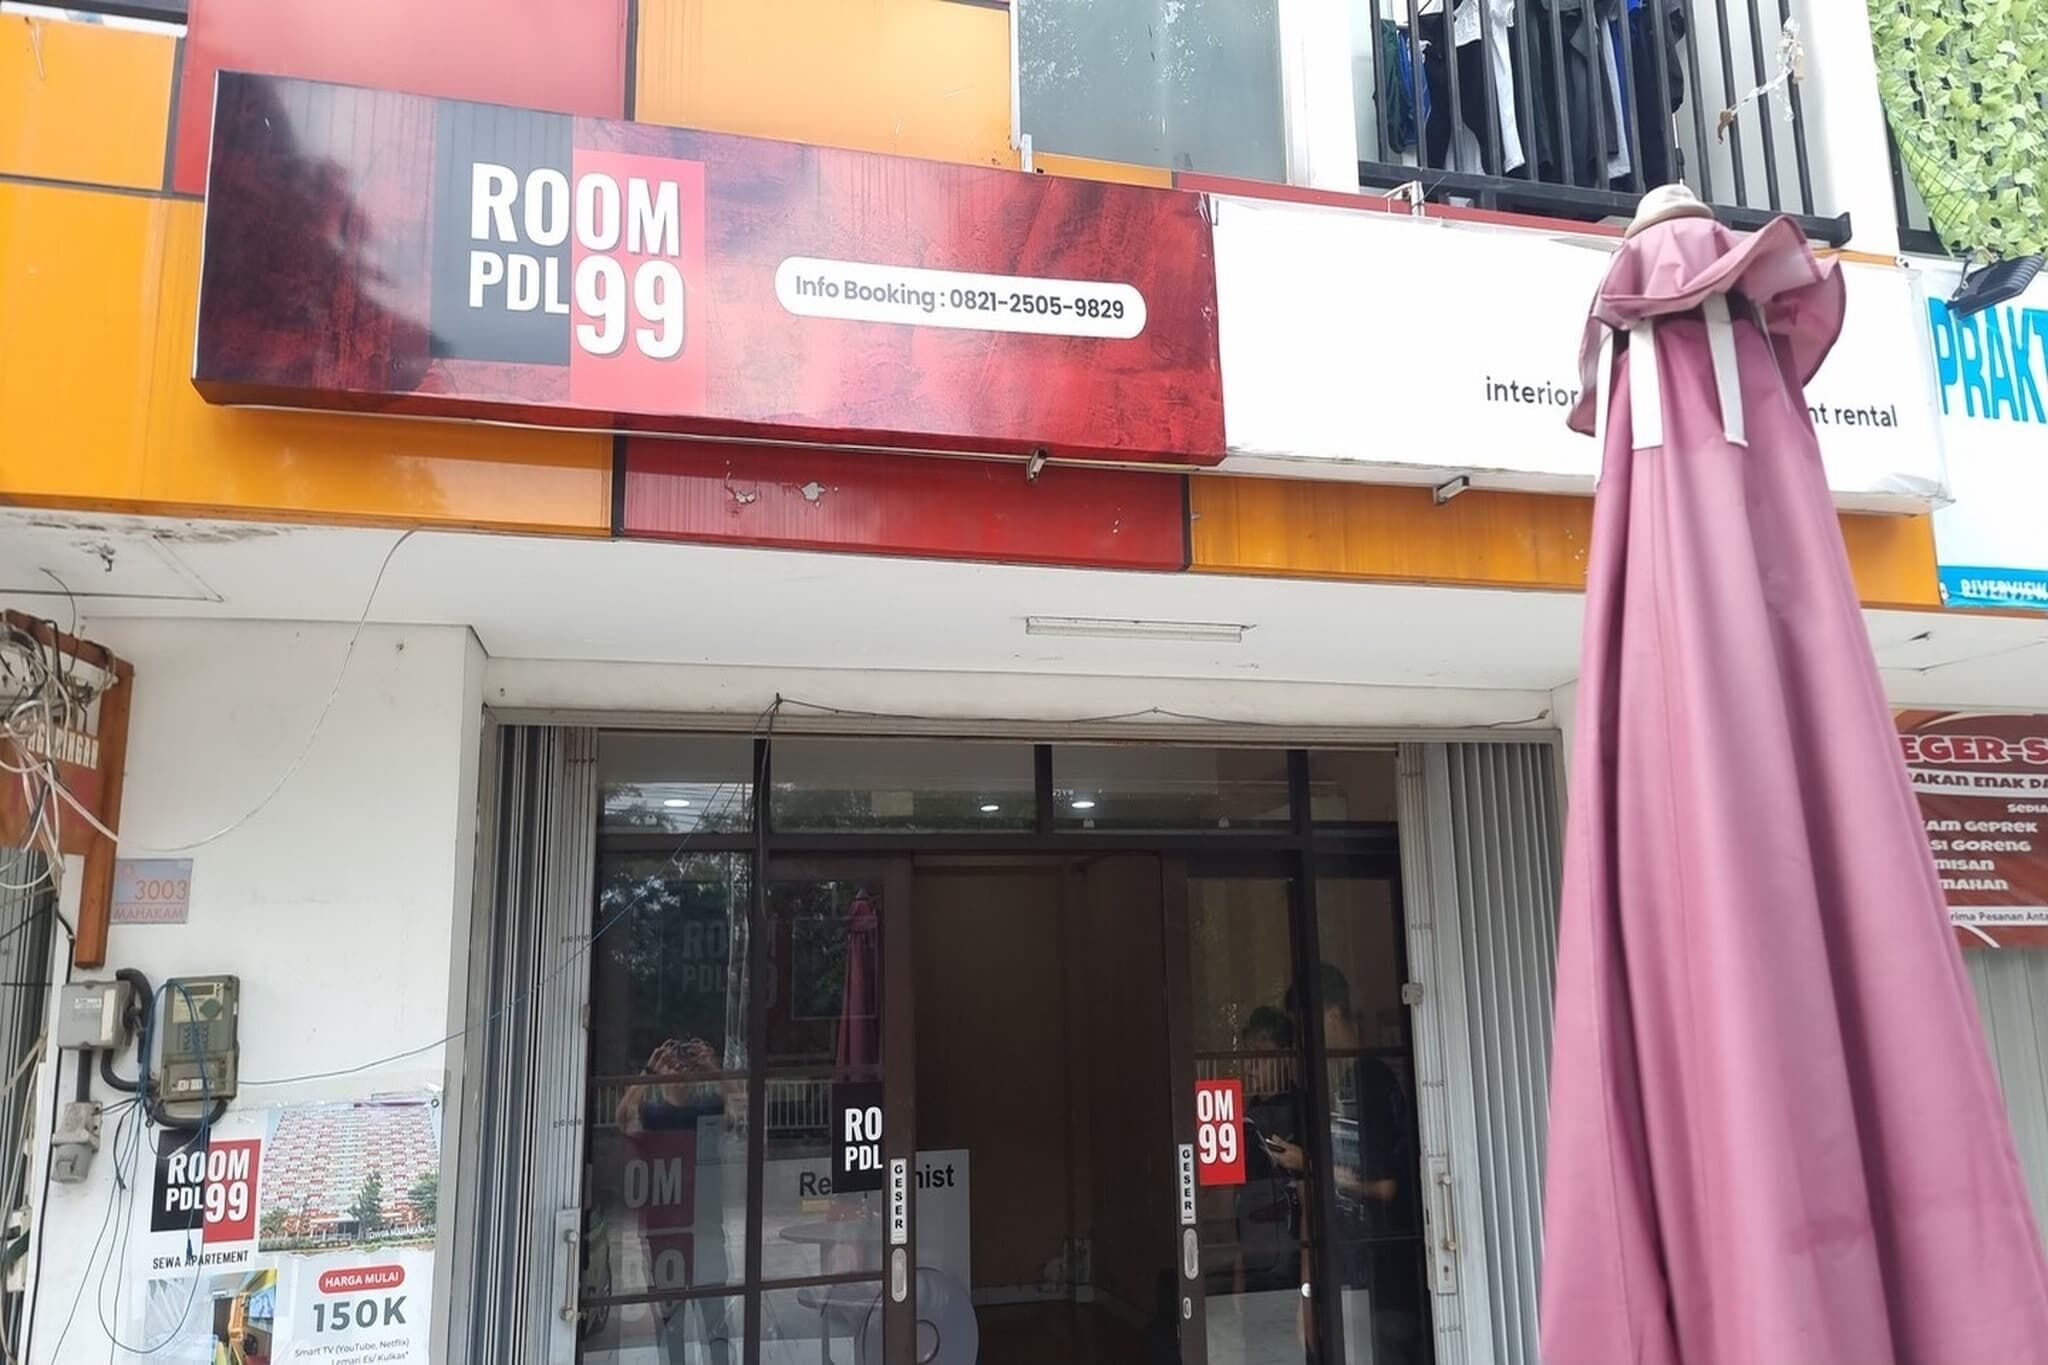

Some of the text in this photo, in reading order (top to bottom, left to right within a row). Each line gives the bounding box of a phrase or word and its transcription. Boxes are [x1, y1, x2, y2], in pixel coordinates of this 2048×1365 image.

[471, 162, 680, 257] ROOM
[468, 250, 686, 360] PDL 99
[796, 275, 838, 298] Info
[844, 280, 935, 313] Booking
[950, 288, 1125, 320] 0821-2505-9829
[1486, 376, 1578, 407] interior
[1835, 404, 1898, 428] rental
[134, 879, 187, 901] 3003
[1197, 1089, 1234, 1122] OM
[844, 1106, 883, 1142] RO
[844, 1144, 884, 1172] PDL
[1198, 1122, 1238, 1164] 99
[167, 1148, 251, 1185] ROOM
[1182, 1148, 1193, 1211] GESER
[165, 1181, 249, 1223] PDL 99
[893, 1163, 904, 1230] GESER
[152, 1256, 182, 1270] SEWA
[324, 1272, 399, 1288] HARGA MULAI
[313, 1295, 407, 1332] 150K
[294, 1347, 321, 1358] Smart
[323, 1345, 335, 1355] TV
